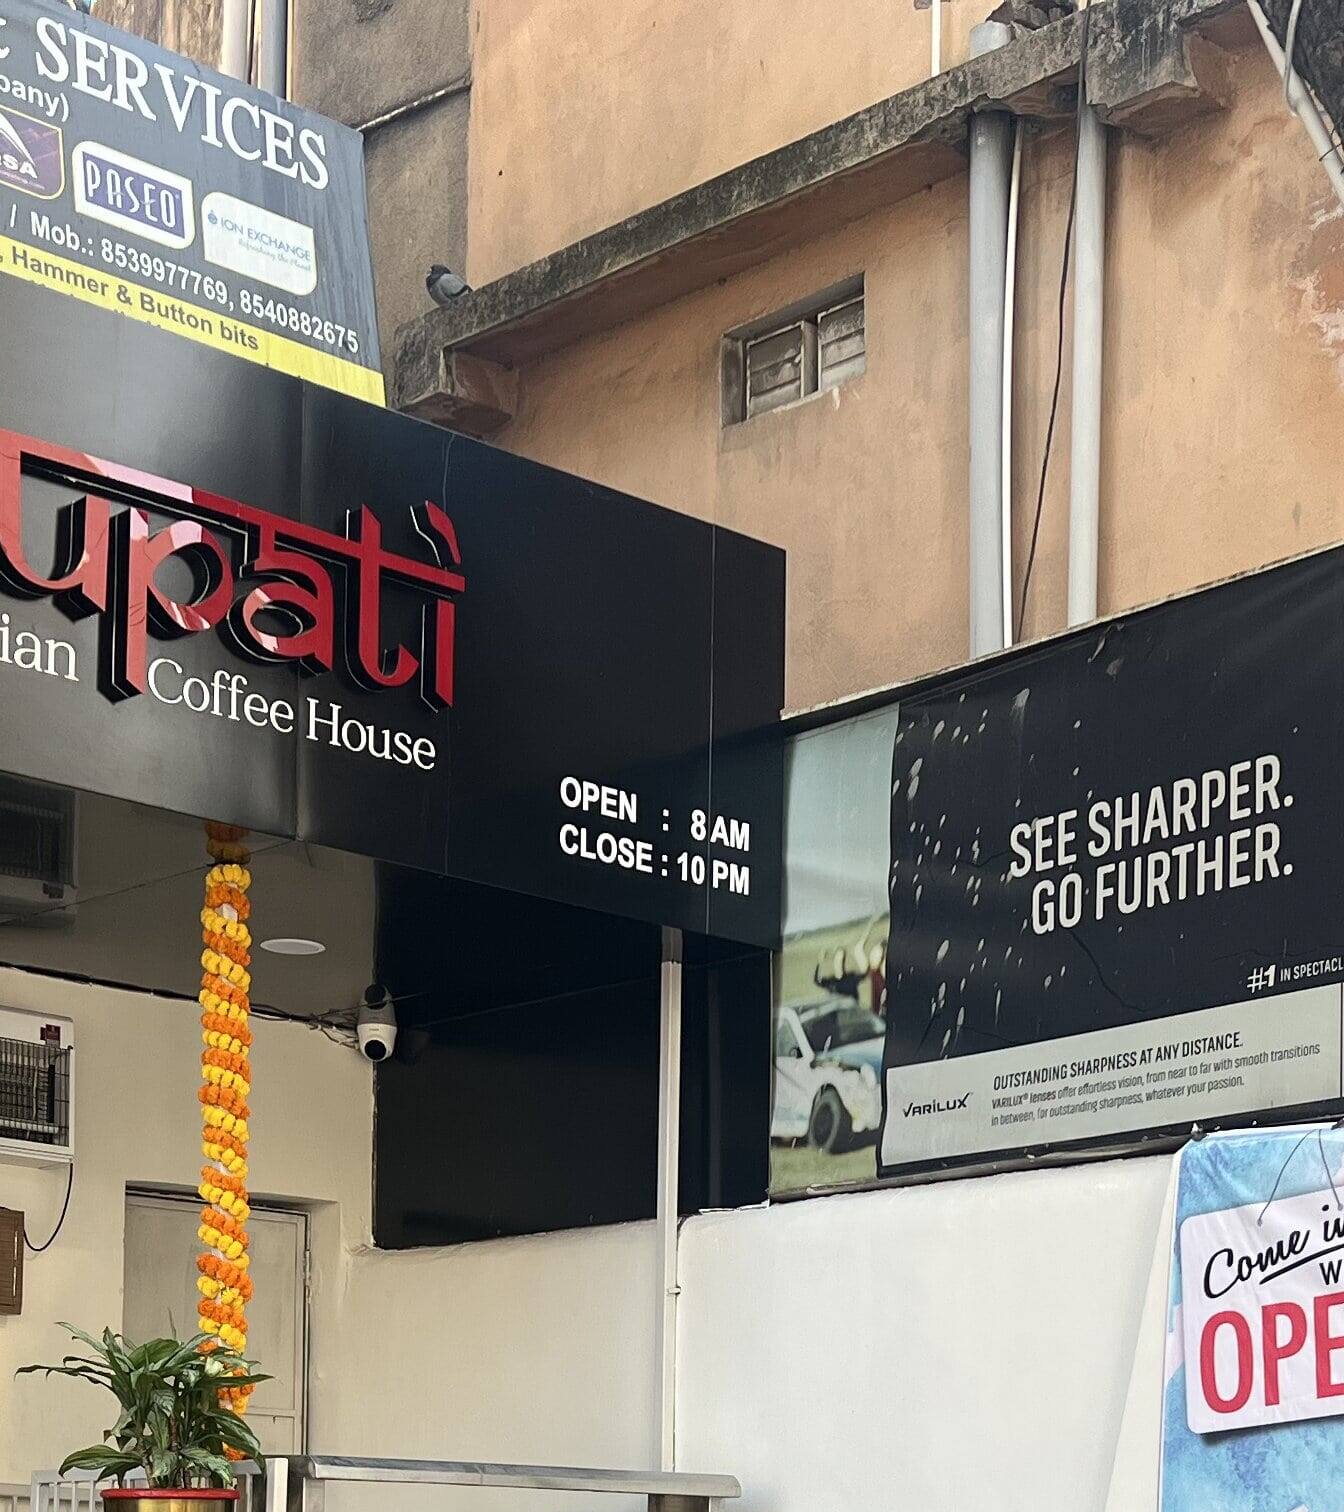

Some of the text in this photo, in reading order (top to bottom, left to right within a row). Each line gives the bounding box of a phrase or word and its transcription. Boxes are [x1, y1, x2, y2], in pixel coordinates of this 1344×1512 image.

[36, 16, 328, 190] SERVICES
[85, 159, 178, 228] PASEO
[221, 217, 244, 236] ION
[247, 228, 312, 261] EXCHANGE
[12, 246, 109, 298] Hammer
[116, 285, 133, 306] &
[140, 291, 213, 337] Button
[220, 320, 259, 352] bits
[30, 211, 94, 257] Mob.:
[101, 238, 235, 312] 8539977769,
[240, 290, 360, 354] 8540882675
[147, 657, 294, 734] Coffee
[305, 696, 437, 770] House
[560, 776, 637, 824] OPEN
[690, 809, 706, 841] 8
[710, 815, 750, 852] AM
[1009, 754, 1294, 878] SEE SHARPER.
[676, 852, 705, 885] 10
[712, 859, 750, 896] PM
[1032, 822, 1294, 935] GO FURTHER.
[1246, 964, 1276, 994] #1
[1280, 967, 1292, 982] IN
[993, 1031, 1244, 1091] OUTSTANDING SHARPNESS AT ANY DISTANCE.
[1030, 1089, 1056, 1104] lenses
[1058, 1085, 1077, 1100] offer
[1077, 1079, 1116, 1096] effortless
[1146, 1070, 1166, 1084] from
[1168, 1067, 1187, 1080] near
[1188, 1064, 1198, 1076] to
[1200, 1061, 1212, 1075] far
[1213, 1058, 1233, 1073] with
[1234, 1053, 1269, 1069] smooth
[1270, 1043, 1321, 1062] transitions
[903, 1092, 971, 1118] VARILUX
[1037, 1107, 1048, 1120] for
[1049, 1100, 1098, 1119] outstanding
[1145, 1086, 1186, 1102] whatever
[1187, 1082, 1207, 1097] your
[1203, 1229, 1311, 1299] Come
